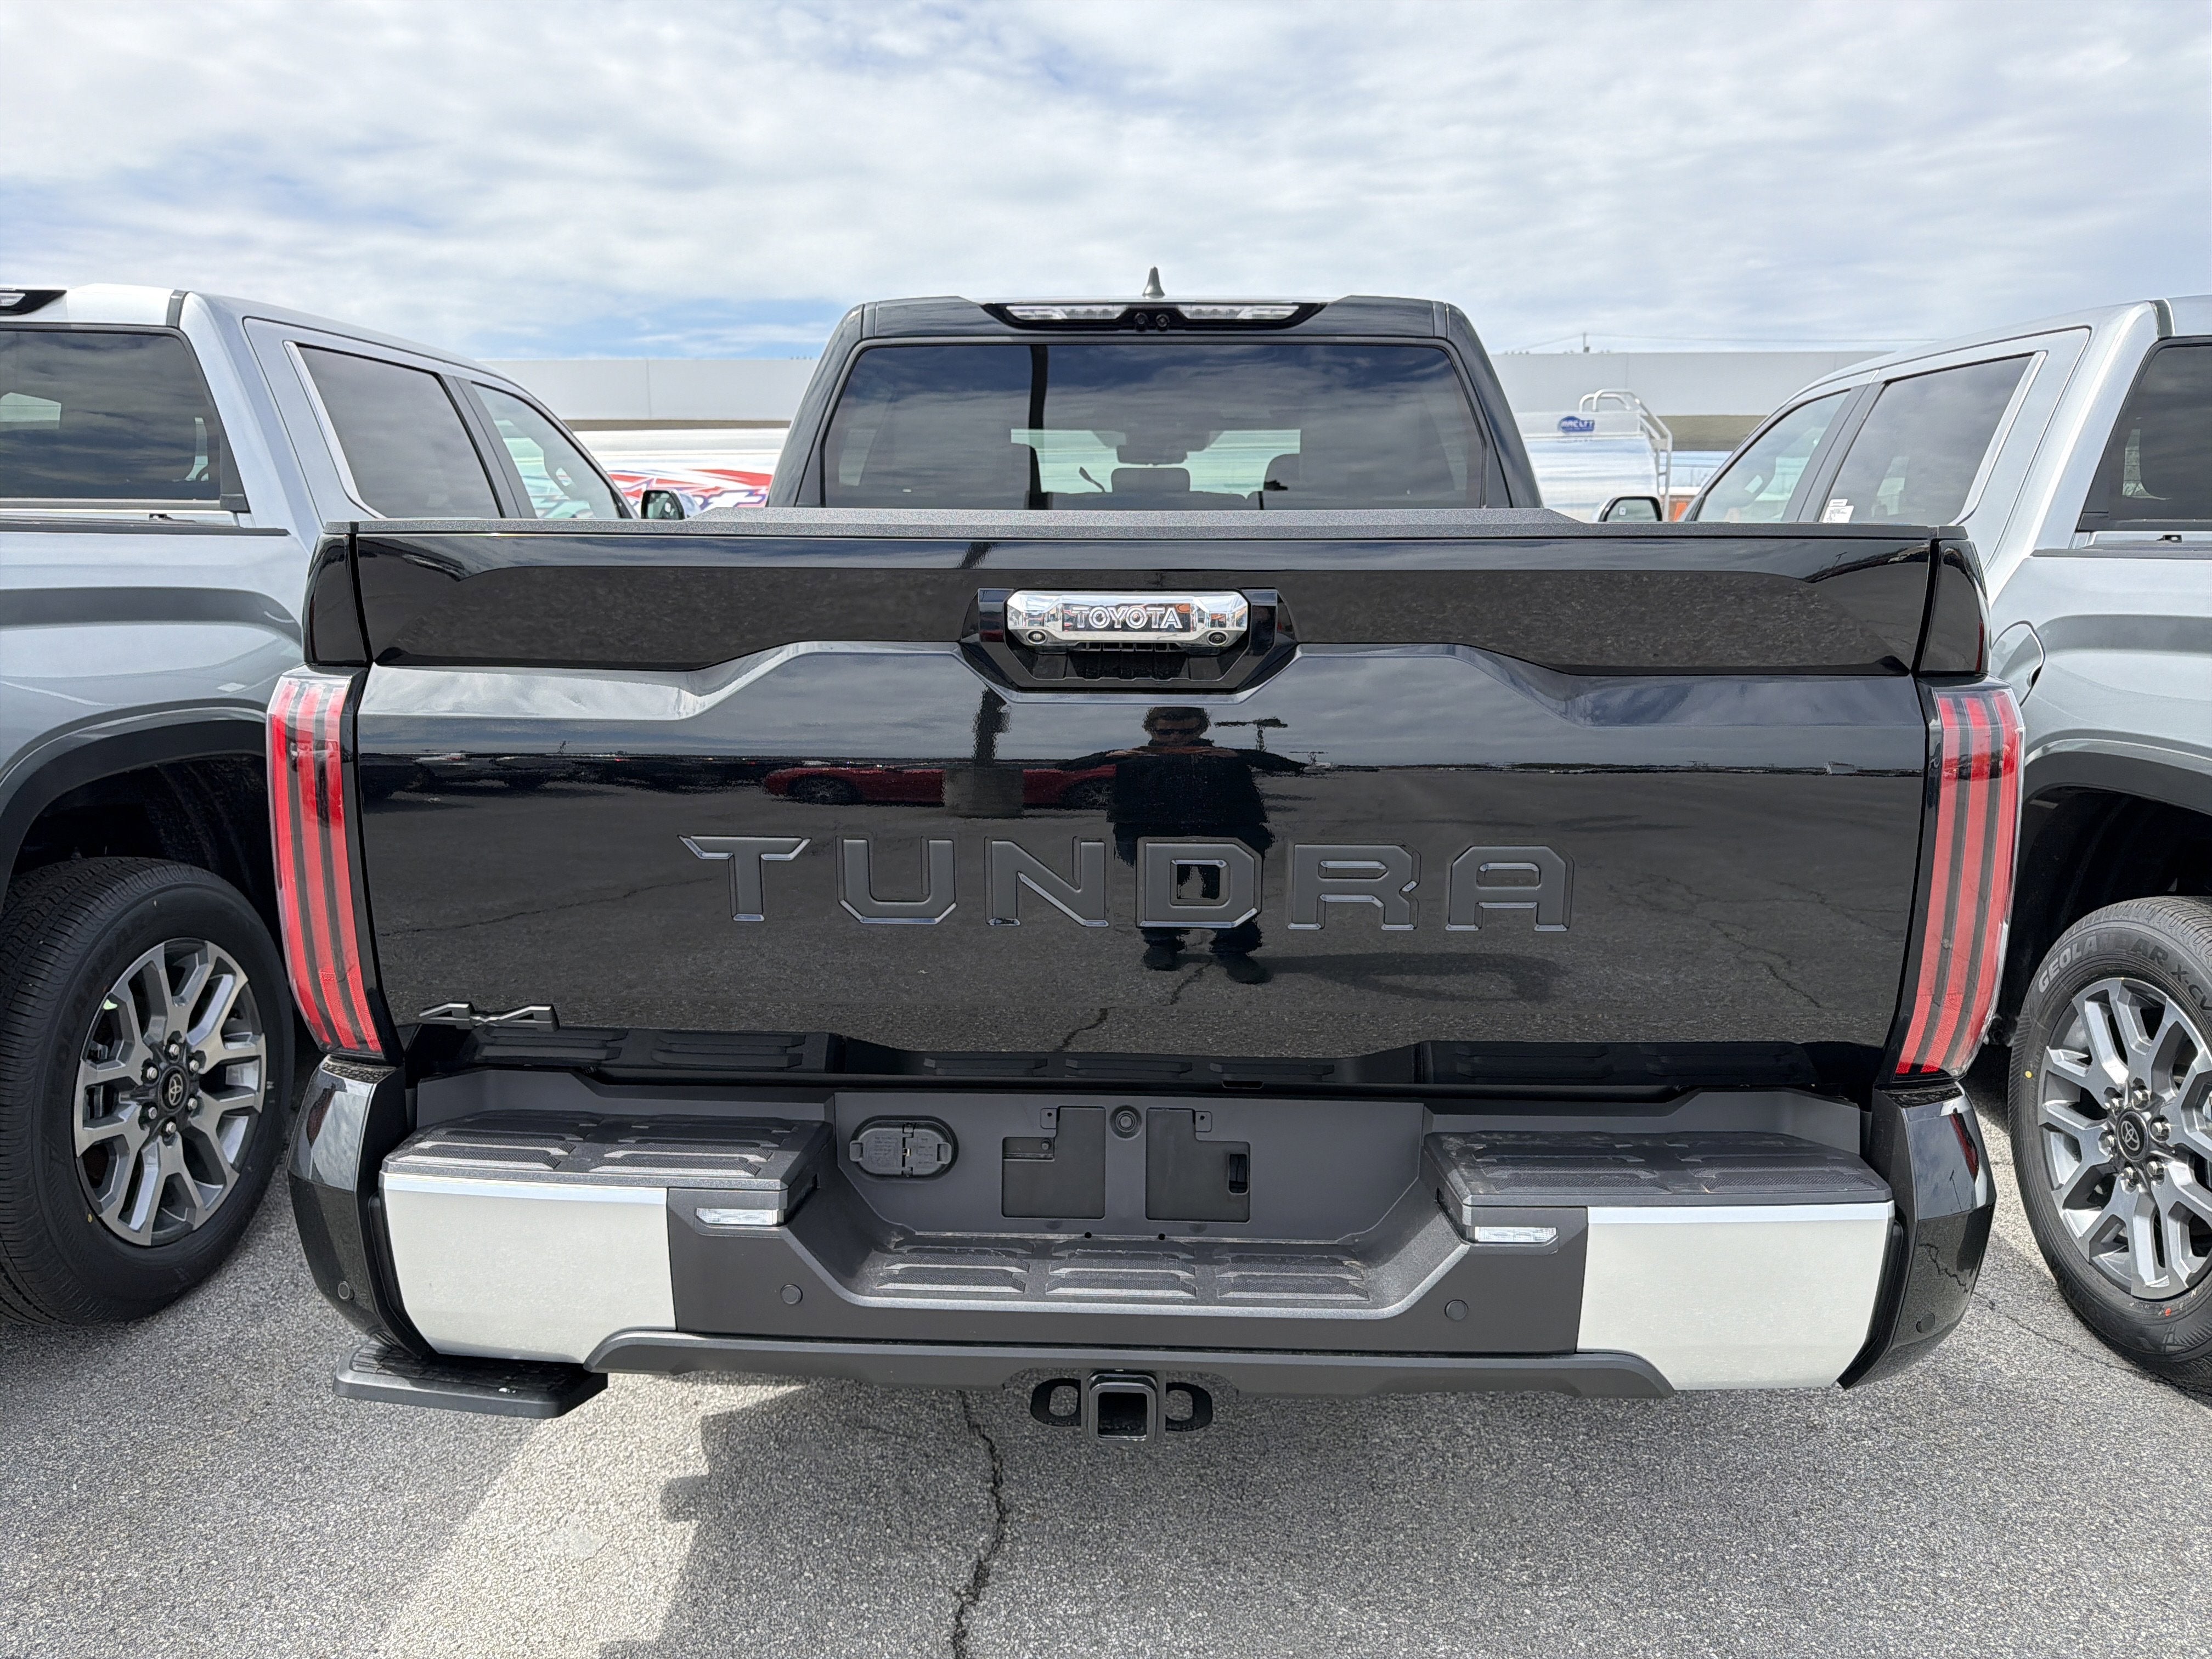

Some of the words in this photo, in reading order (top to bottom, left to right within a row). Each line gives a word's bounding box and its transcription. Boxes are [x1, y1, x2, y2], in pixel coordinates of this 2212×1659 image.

[1071, 606, 1182, 629] TOYOTA
[678, 834, 1573, 934] TUNDRA
[2038, 934, 2169, 993] GEOLAAR
